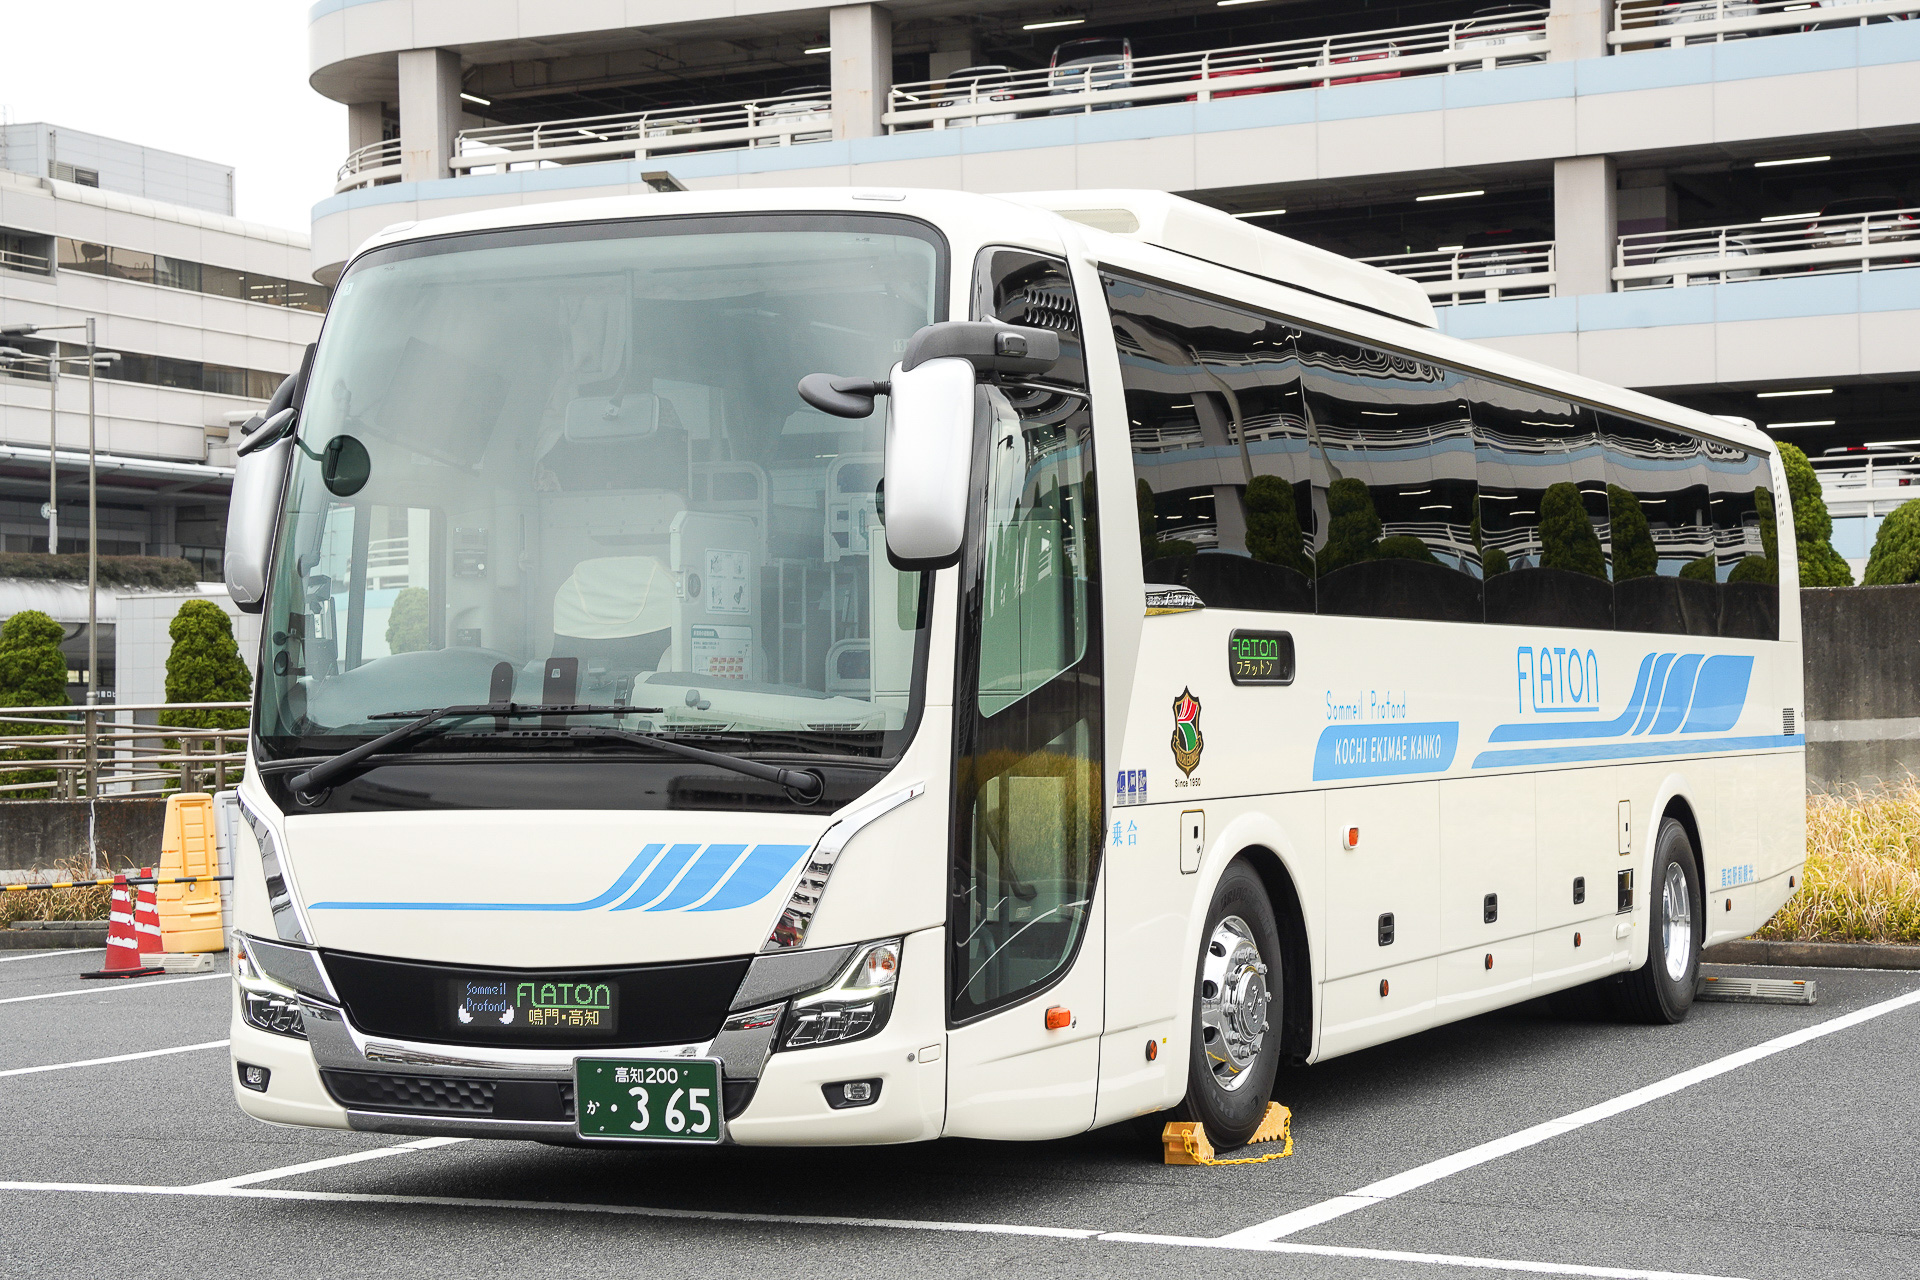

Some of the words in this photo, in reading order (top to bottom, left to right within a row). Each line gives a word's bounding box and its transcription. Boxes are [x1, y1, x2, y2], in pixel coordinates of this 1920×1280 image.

[1236, 660, 1273, 676] フラットン
[1517, 646, 1600, 713] FLATON
[1326, 690, 1363, 720] Sommeil
[1370, 690, 1406, 719] Profond
[1334, 737, 1368, 765] KOCHI
[1370, 735, 1408, 763] EKIMAE
[1410, 734, 1442, 760] KANKO
[1174, 778, 1188, 788] Since
[1112, 819, 1138, 847] 乗合
[466, 981, 507, 996] Sommeil
[516, 982, 610, 1009] FLATON
[466, 998, 507, 1012] Profond
[528, 1008, 600, 1027] 鳴門・高知
[586, 1100, 600, 1115] か
